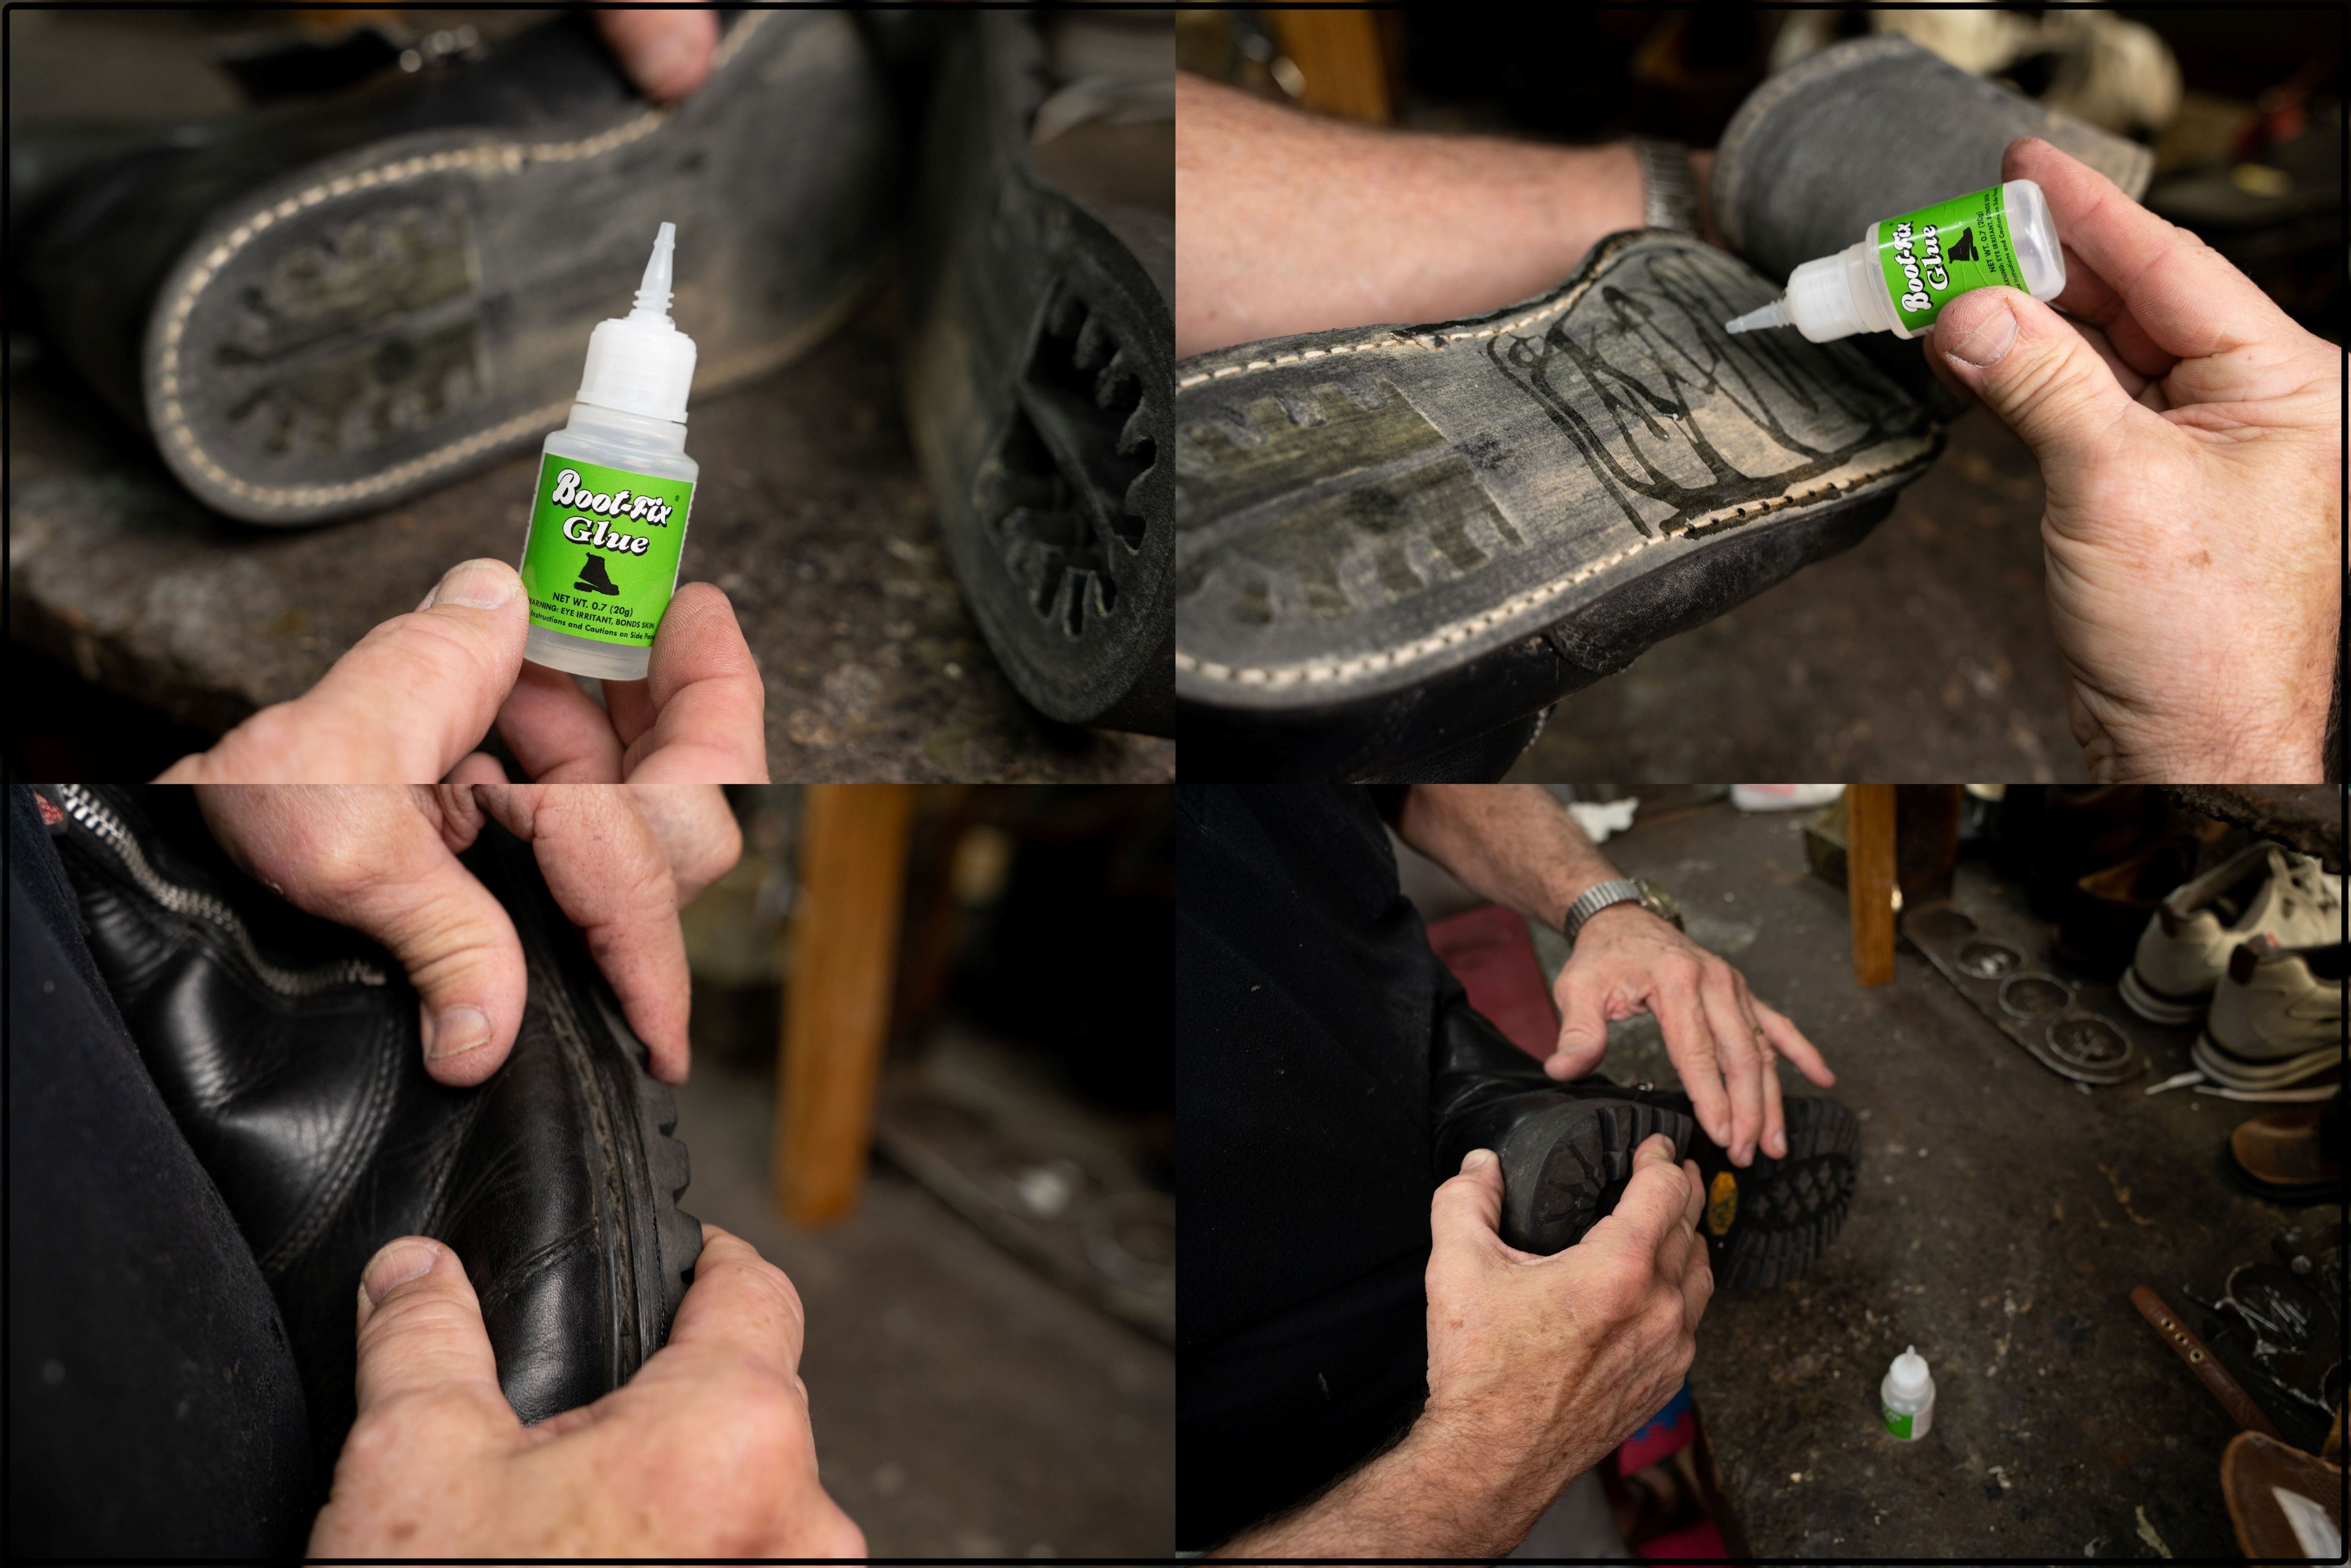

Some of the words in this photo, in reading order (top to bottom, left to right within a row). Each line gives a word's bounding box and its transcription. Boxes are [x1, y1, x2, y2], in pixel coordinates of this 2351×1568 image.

[1976, 211, 1985, 228] (20g)
[1979, 230, 1987, 242] 0.7
[1987, 220, 1998, 249] IRRITANT,
[1920, 224, 1950, 291] Glue
[1982, 243, 1991, 257] WT.
[1892, 220, 1934, 313] Boot-Fix
[1986, 258, 1997, 273] NET
[1998, 263, 2012, 287] ARNING:
[2006, 252, 2019, 283] Instructions
[552, 468, 673, 528] Boot-Fix
[562, 516, 650, 556] Glue
[528, 596, 559, 613] WARNING:
[560, 607, 575, 617] EYE
[576, 611, 613, 625] IRRITANT,
[615, 618, 640, 628] BONDS
[552, 591, 571, 604] NET
[573, 597, 588, 609] WT.
[591, 601, 607, 611] 0.7
[610, 605, 633, 618] (20g)
[530, 610, 566, 626] Instructions
[585, 625, 617, 636] Cautions
